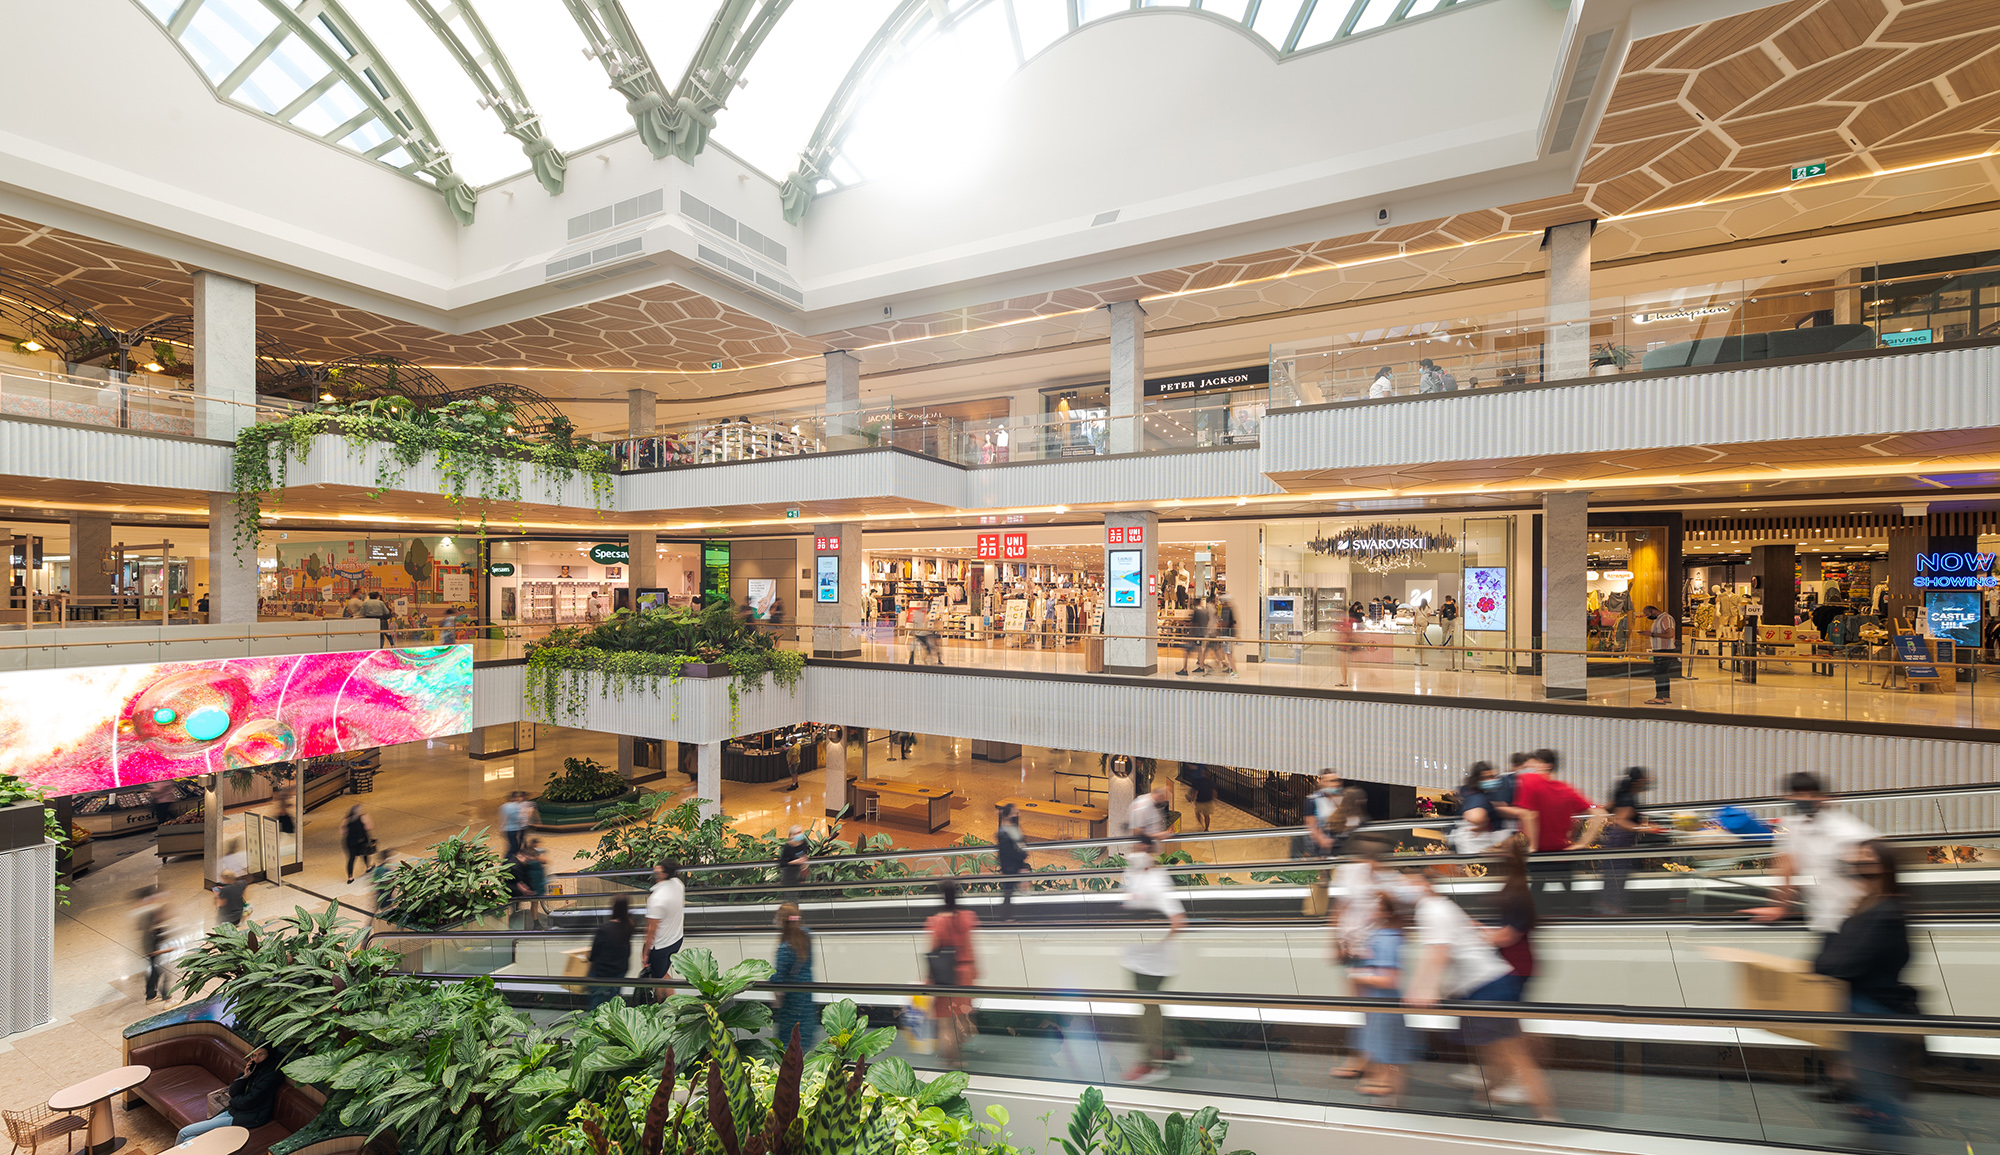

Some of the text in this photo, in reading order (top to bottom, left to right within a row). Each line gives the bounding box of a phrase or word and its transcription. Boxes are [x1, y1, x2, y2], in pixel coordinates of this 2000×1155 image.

[1632, 306, 1730, 324] Champion
[1160, 374, 1249, 392] PETER JACKSON
[1006, 536, 1023, 546] UNI
[1352, 538, 1424, 550] SWAROVSKI
[1006, 546, 1024, 557] QLO
[1916, 552, 1996, 572] NOW
[1913, 576, 1998, 588] SHOWING
[1931, 612, 1976, 621] CASTLE
